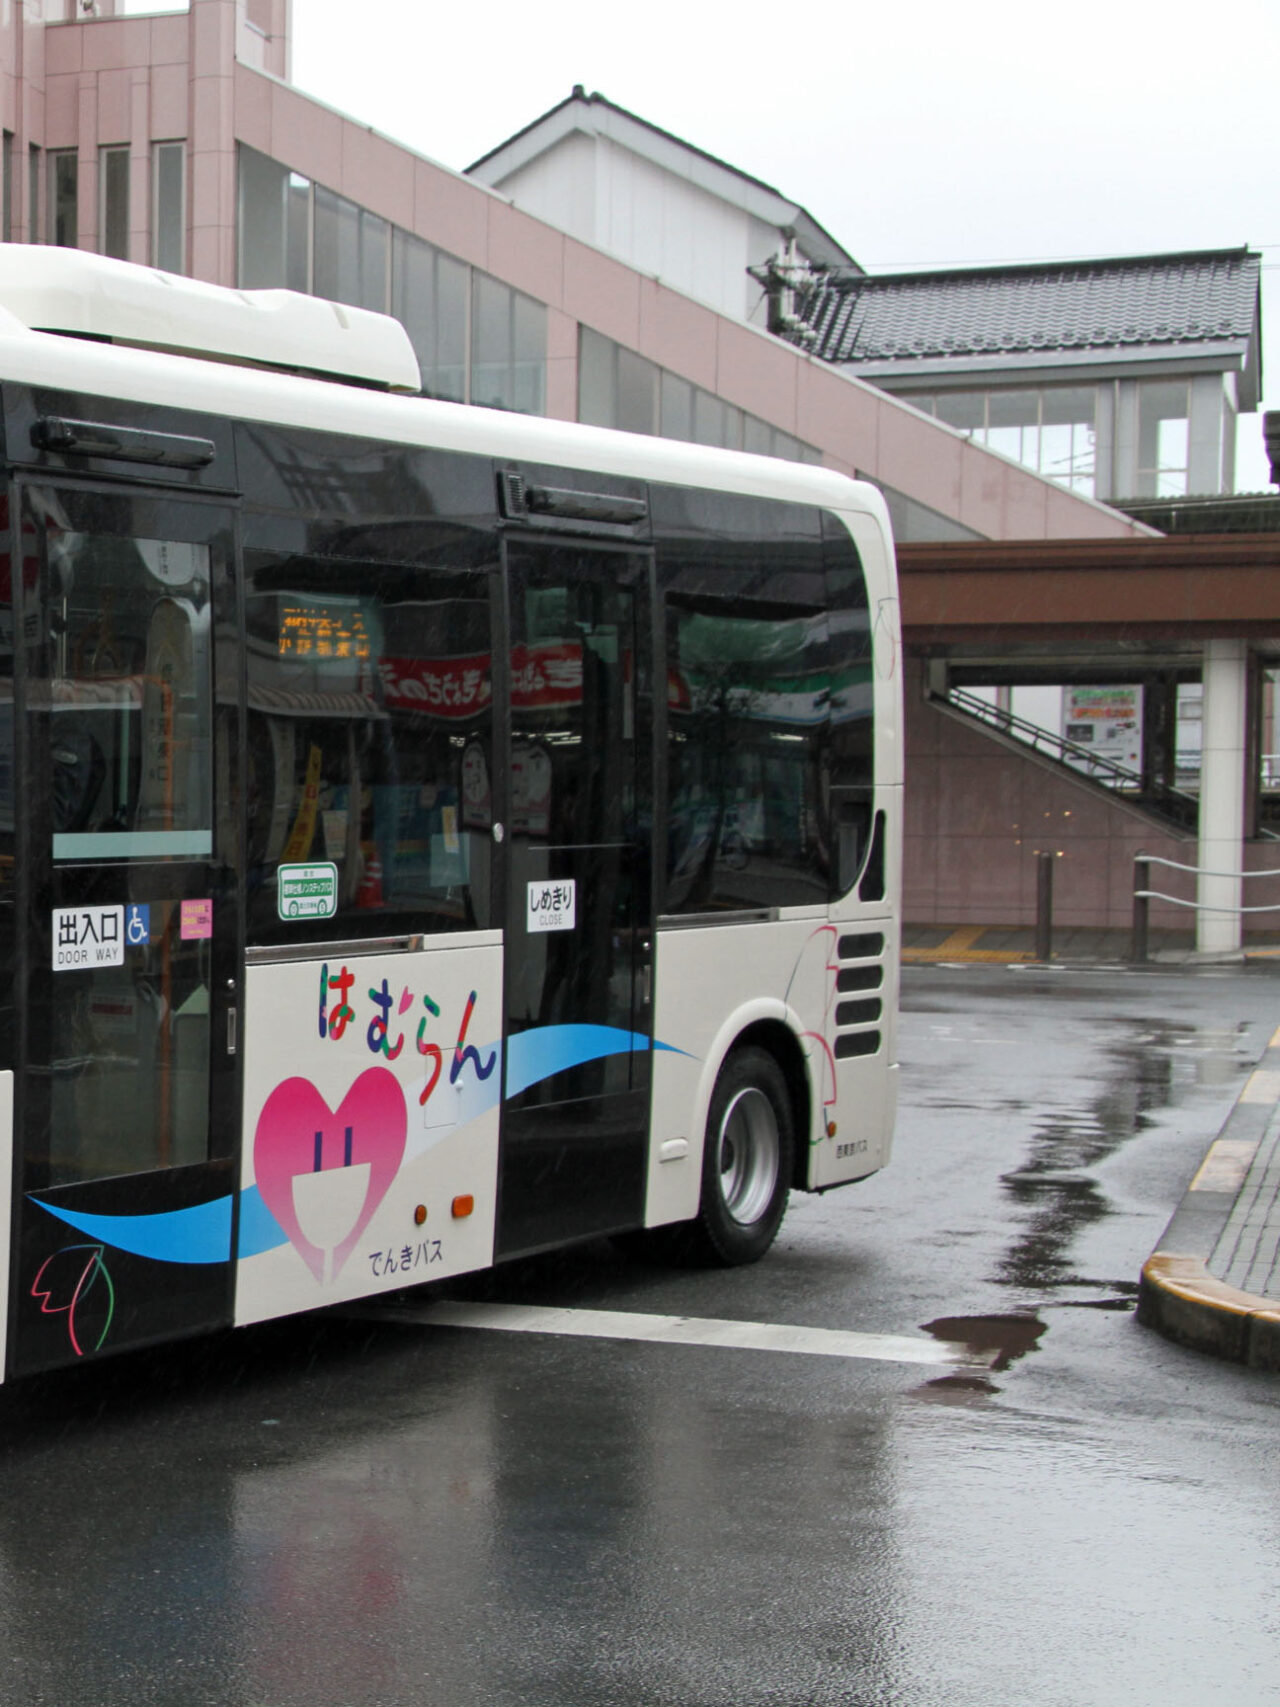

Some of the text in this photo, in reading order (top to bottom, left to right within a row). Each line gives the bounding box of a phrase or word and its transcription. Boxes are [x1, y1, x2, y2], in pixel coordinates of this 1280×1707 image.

[530, 886, 572, 912] しめきり
[58, 912, 118, 947] 出入口
[540, 913, 563, 926] CLOSE
[58, 948, 118, 964] DOOR WAY
[318, 963, 497, 1107] はむらん
[369, 1239, 443, 1277] でんきバス
